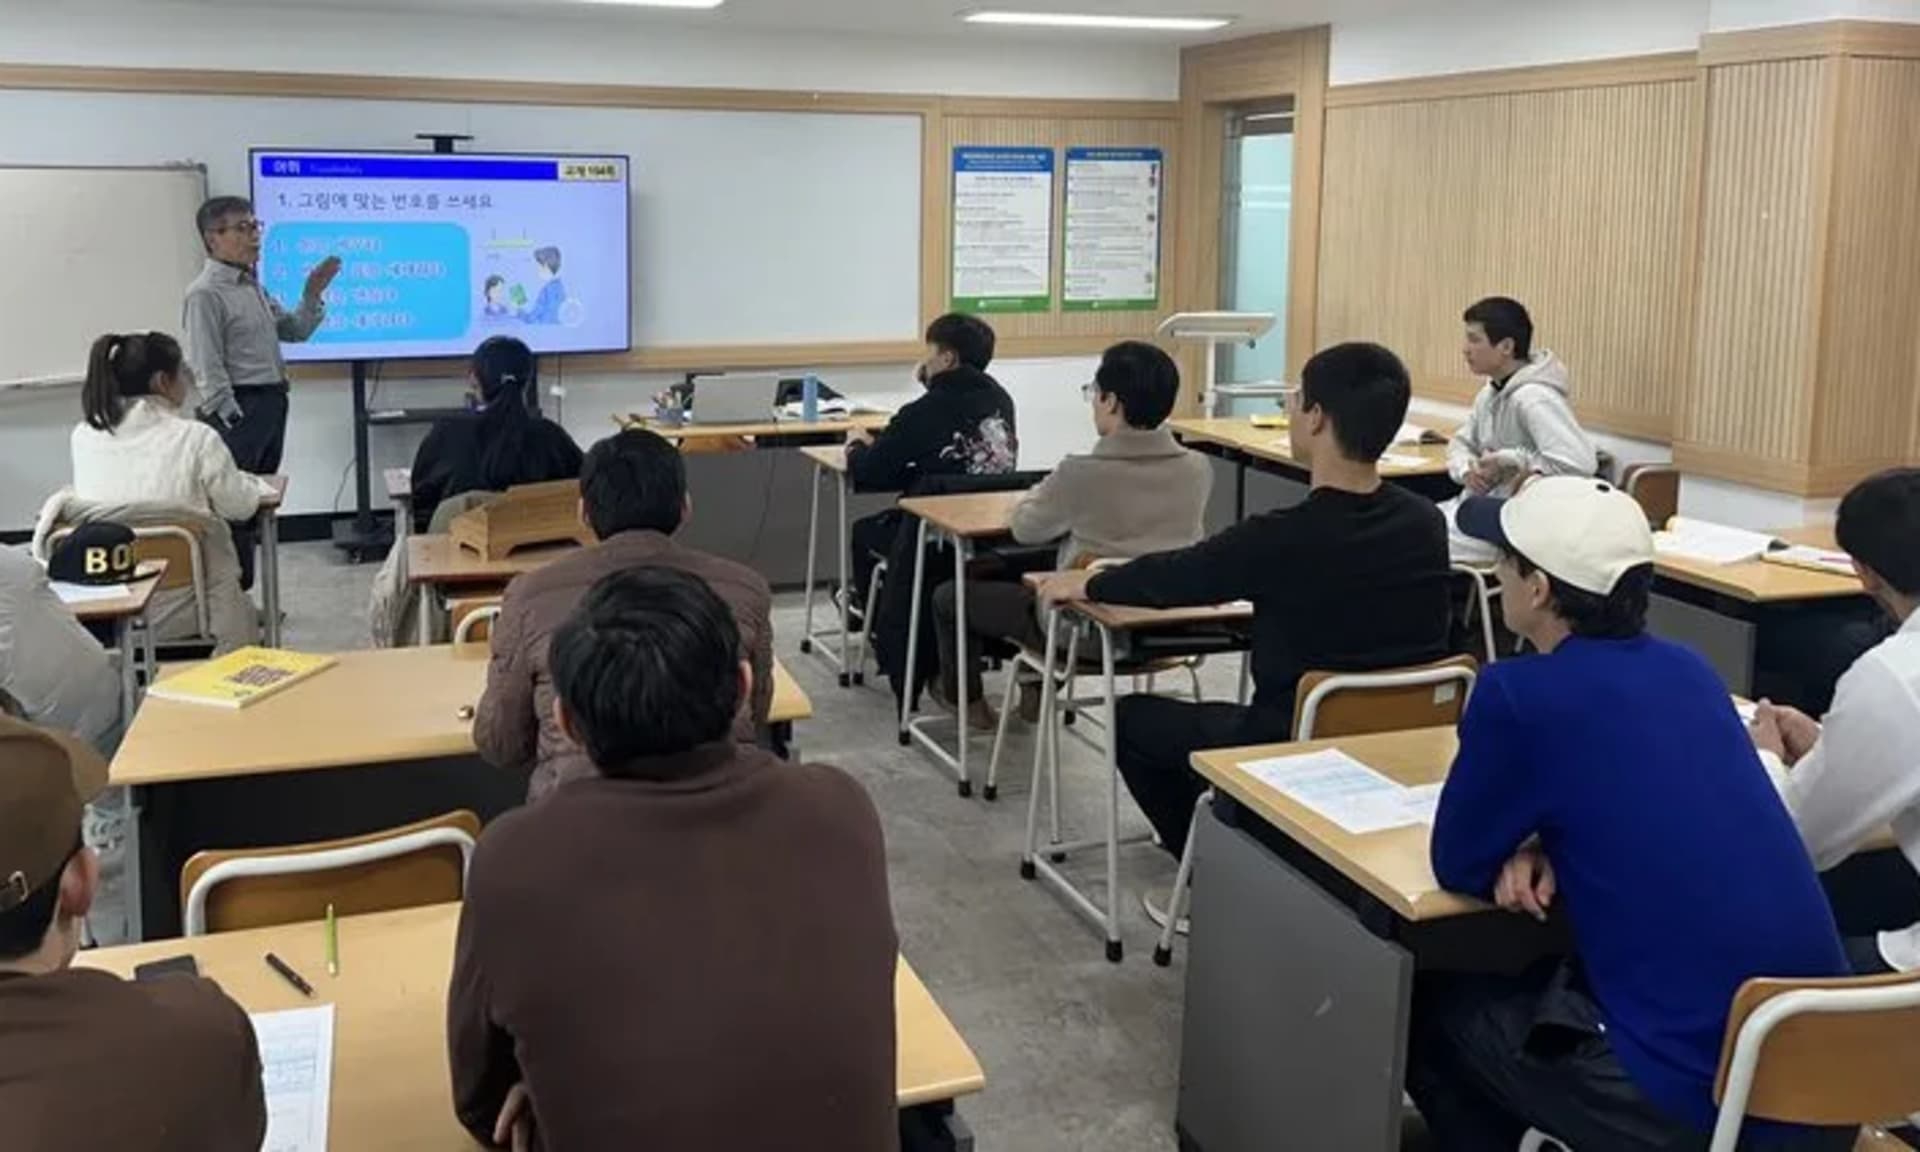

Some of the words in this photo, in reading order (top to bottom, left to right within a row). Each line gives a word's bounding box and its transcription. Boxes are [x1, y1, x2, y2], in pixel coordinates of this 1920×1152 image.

[279, 192, 293, 208] 1.
[298, 191, 348, 210] 그림에
[353, 191, 386, 210] 맞는
[391, 191, 440, 210] 번호를
[447, 192, 493, 210] 쓰세요
[85, 543, 135, 575] BO
